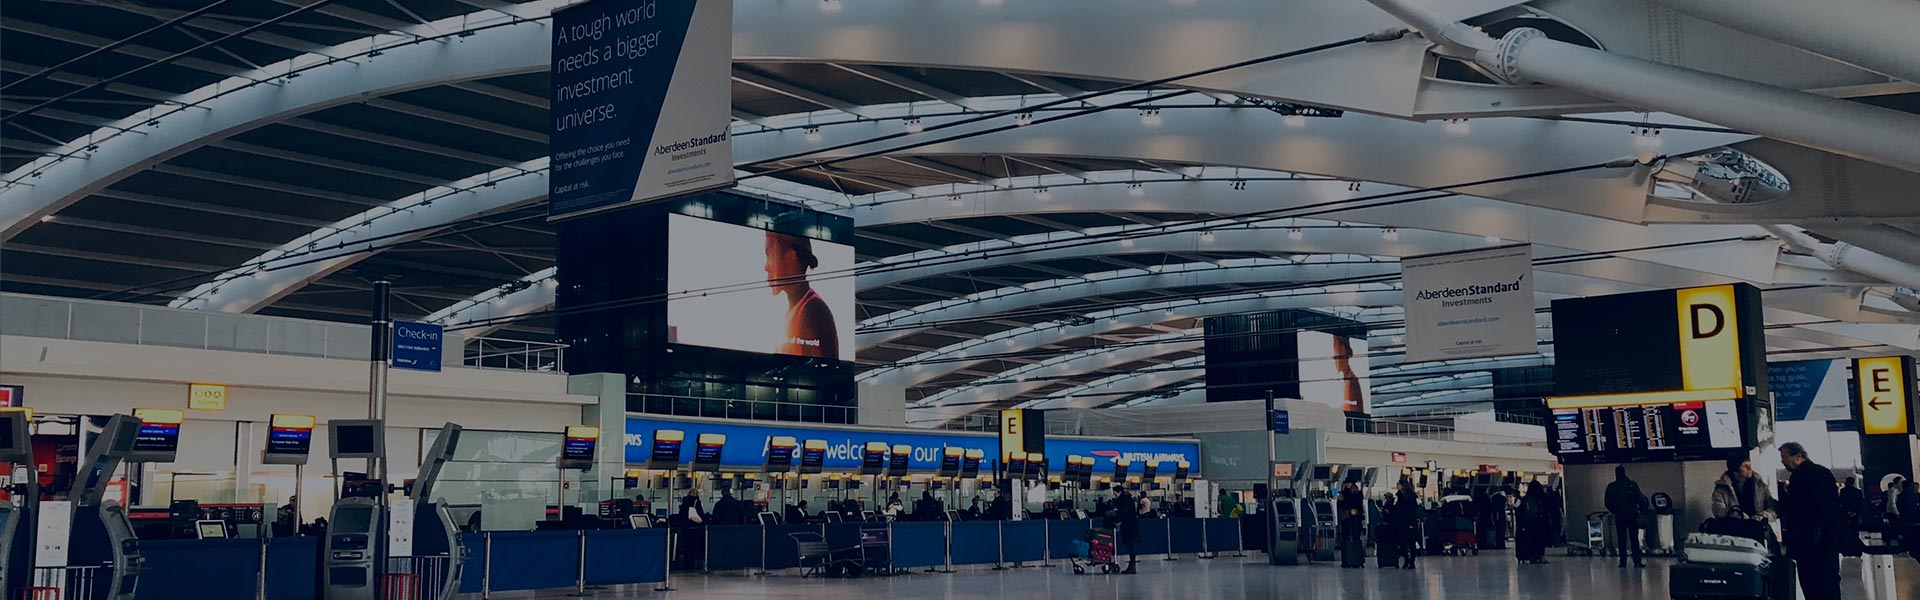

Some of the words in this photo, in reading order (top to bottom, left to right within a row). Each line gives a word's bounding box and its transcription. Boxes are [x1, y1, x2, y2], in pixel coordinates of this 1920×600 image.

[557, 26, 568, 46] A
[571, 12, 611, 40] tough
[615, 1, 656, 28] world
[557, 45, 599, 73] needs
[603, 45, 612, 61] a
[617, 30, 662, 60] bigger
[557, 68, 634, 103] investment
[556, 103, 617, 132] universe.
[555, 151, 577, 162] Offering
[587, 144, 604, 154] choice
[605, 142, 615, 153] you
[616, 137, 631, 147] need
[653, 131, 726, 156] AberdeenStandard
[671, 148, 707, 162] Investments
[573, 156, 600, 168] challenges
[601, 153, 611, 165] you
[1415, 280, 1520, 300] AberdeenStandard
[1442, 296, 1493, 308] Investments
[397, 326, 438, 340] Check-in
[1690, 303, 1725, 339] D
[805, 338, 820, 347] world
[1872, 368, 1891, 392] E
[1008, 417, 1017, 434] E
[624, 433, 643, 447] AYS
[826, 438, 891, 461] welcoe
[914, 446, 940, 462] our
